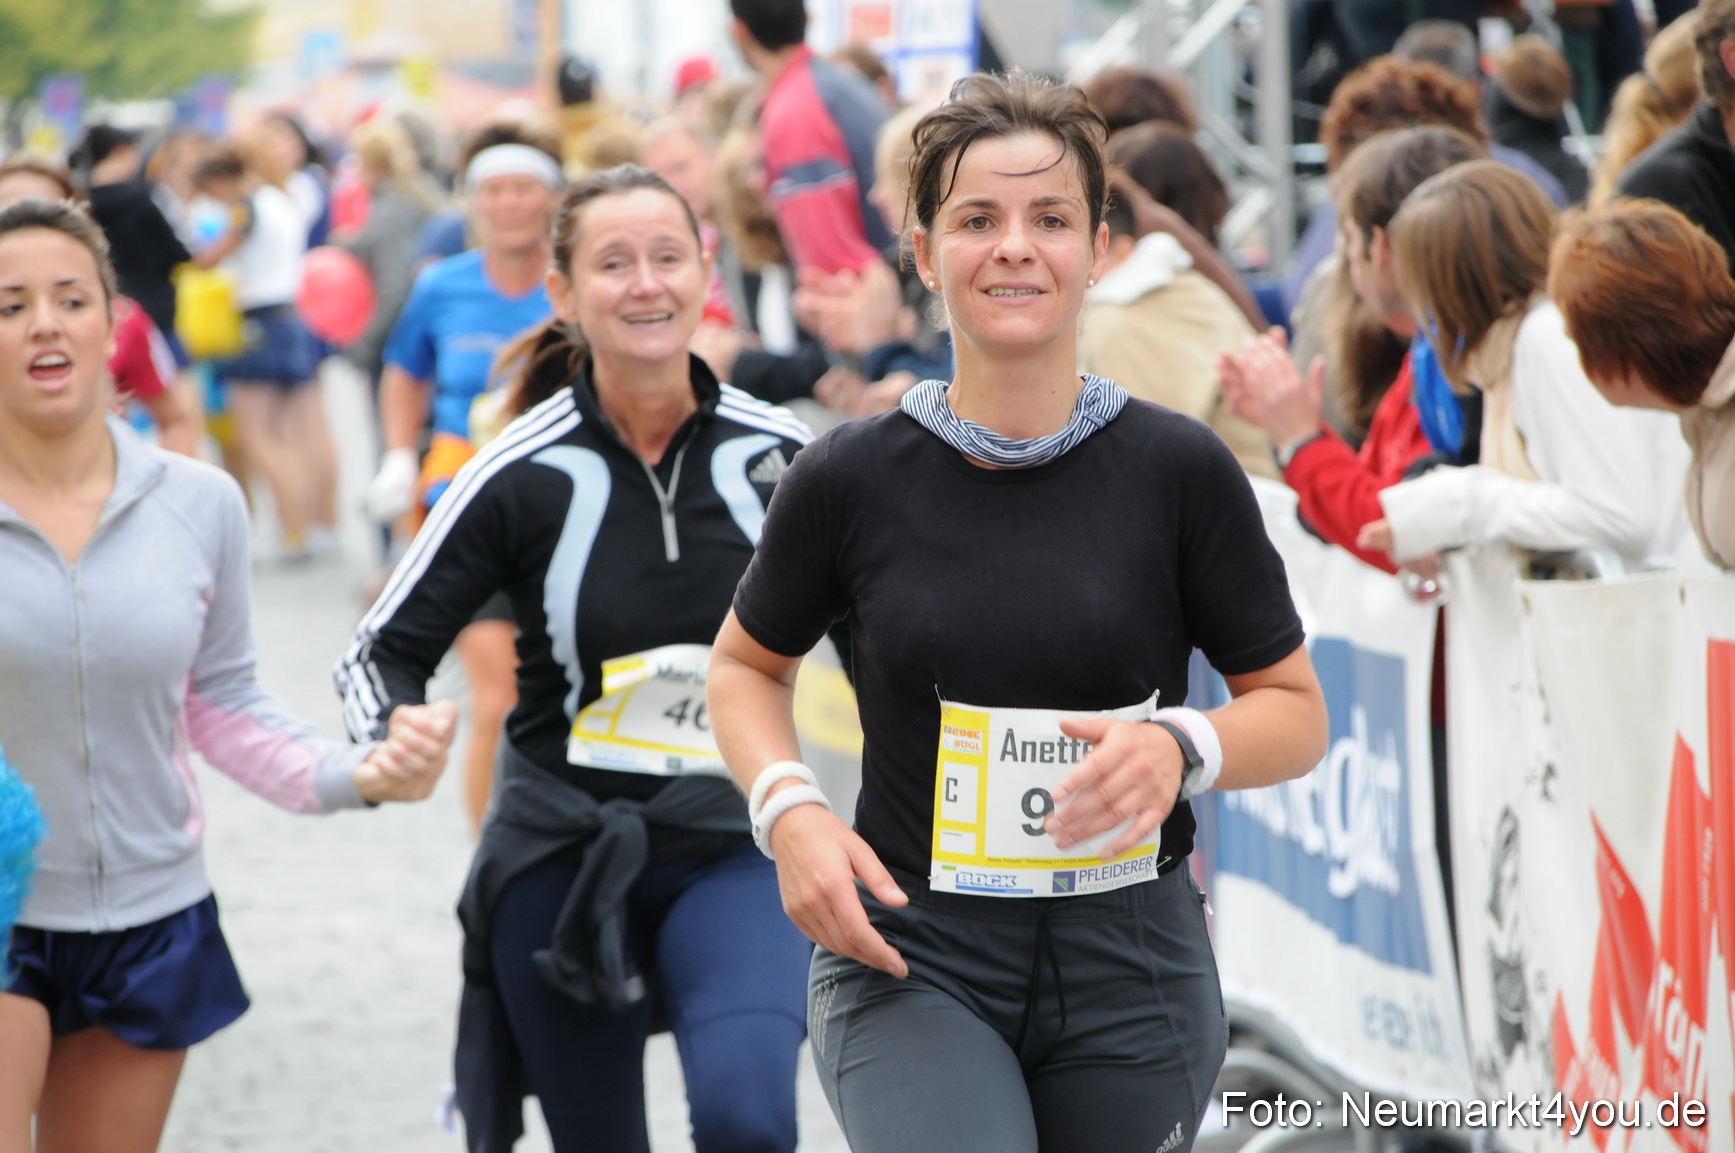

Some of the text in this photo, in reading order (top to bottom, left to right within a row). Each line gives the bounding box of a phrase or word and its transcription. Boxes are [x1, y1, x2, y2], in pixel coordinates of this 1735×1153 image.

[945, 777, 958, 803] C
[955, 871, 1017, 888] BOCK
[1077, 869, 1154, 893] AKTIENGESELLSCHAFT
[1078, 855, 1154, 884] PFLEIDERER
